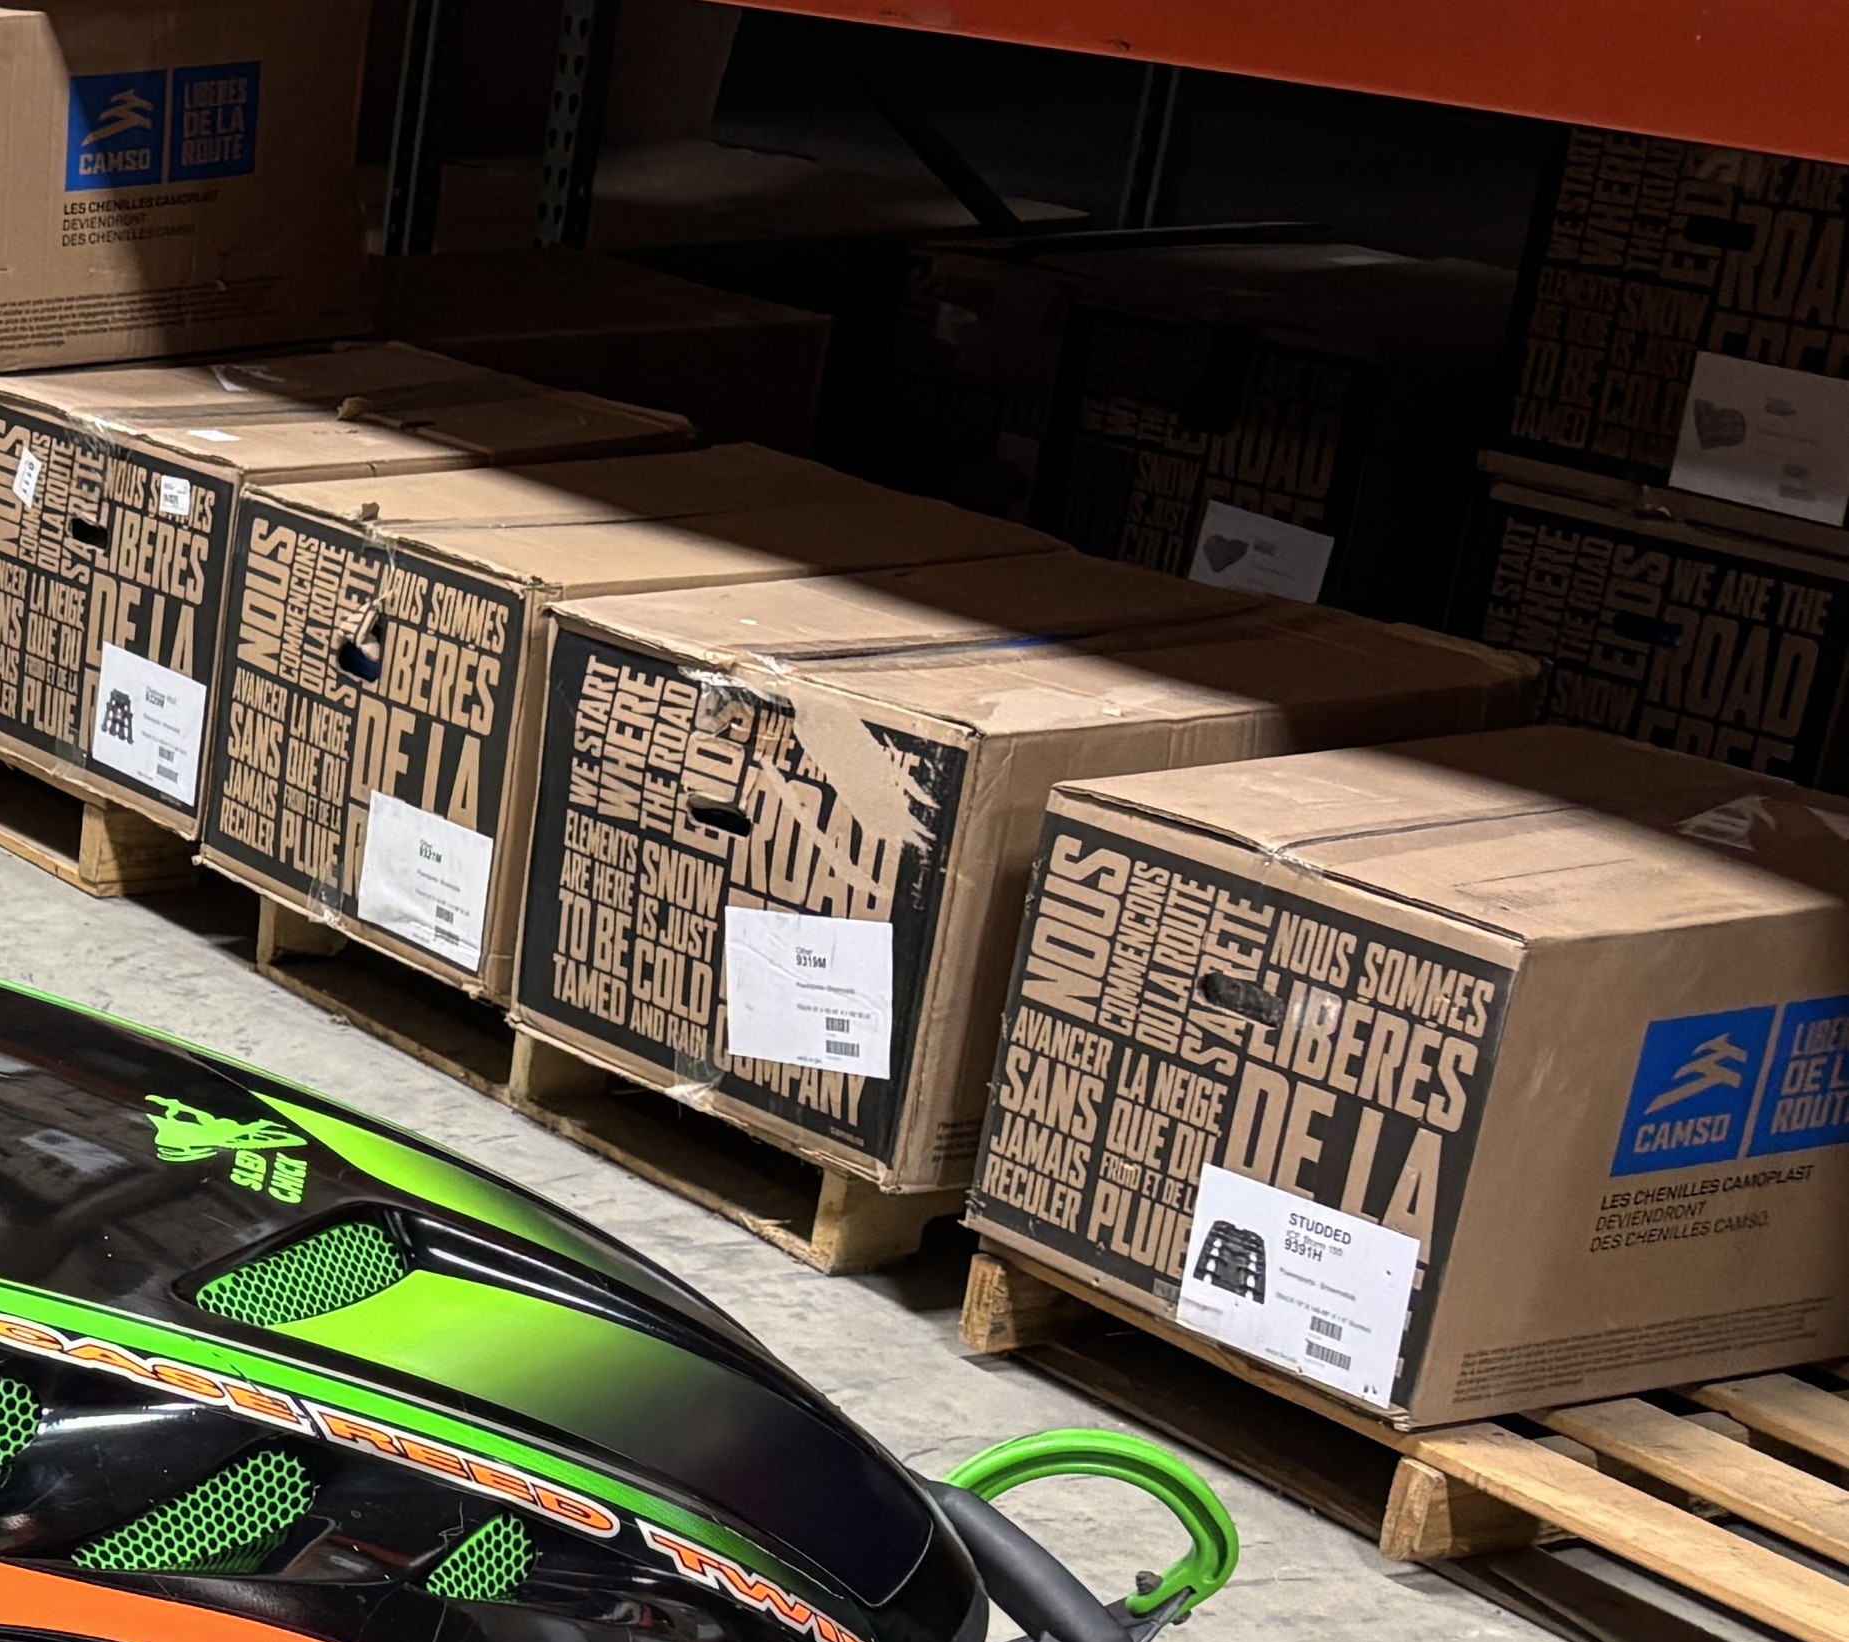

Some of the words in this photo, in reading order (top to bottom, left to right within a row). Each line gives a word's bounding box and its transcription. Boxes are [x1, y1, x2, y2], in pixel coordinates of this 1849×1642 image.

[181, 134, 244, 167] ROUTE
[183, 109, 212, 137] DE
[216, 106, 245, 134] LA
[78, 148, 151, 177] CAMSO
[61, 232, 86, 247] DES
[88, 227, 154, 245] CHENILLES
[62, 212, 147, 232] DEVIENDRONT
[63, 202, 87, 216] LES
[88, 196, 155, 214] CHENILLES
[1617, 278, 1711, 342] SNOW
[44, 437, 75, 512] ROUTE
[104, 457, 148, 510] NOUS
[29, 573, 47, 613] LA
[308, 541, 346, 626] ROUTE
[1490, 516, 1540, 602] START
[1511, 523, 1581, 654] WHERE
[1566, 534, 1616, 612] ROAD
[85, 571, 142, 668] DE
[236, 517, 297, 676] NOUS
[427, 582, 509, 654] SOMMES
[1670, 556, 1718, 608] WE
[1713, 567, 1777, 623] ARE
[1776, 580, 1834, 637] THE
[26, 612, 58, 663] QUE
[58, 624, 84, 673] DU
[1556, 609, 1599, 663] THE
[1645, 603, 1821, 740] ROAD
[21, 675, 78, 746] PLUIE
[231, 667, 288, 723] AVANCER
[289, 692, 308, 737] LA
[574, 654, 622, 758] START
[650, 680, 699, 774] ROAD
[1551, 668, 1639, 734] SNOW
[227, 701, 284, 780] SANS
[285, 737, 320, 800] QUE
[320, 751, 348, 808] DU
[349, 694, 417, 804] DE
[597, 665, 665, 822] WHERE
[753, 708, 796, 772] WE
[223, 761, 279, 820] JAMAIS
[568, 756, 600, 807] WE
[640, 771, 681, 834] THE
[219, 796, 276, 859] RECULER
[279, 808, 341, 889] PLUIE
[564, 808, 639, 874] ELEMENTS
[729, 766, 902, 923] ROAD
[559, 850, 590, 894] ARE
[591, 859, 635, 912] HERE
[639, 839, 725, 920] SNOW
[558, 888, 593, 961] TO
[593, 903, 632, 978] BE
[636, 893, 659, 936] IS
[659, 905, 718, 964] JUST
[1021, 834, 1132, 1024] NOUS
[1151, 873, 1217, 975] ROUTE
[553, 952, 627, 1026] TAMED
[632, 936, 713, 1025] COLD
[1143, 969, 1193, 1013] LA
[1269, 910, 1357, 989] NOUS
[1356, 942, 1494, 1038] SOMMES
[630, 1001, 666, 1045] AND
[666, 1013, 708, 1060] RAIN
[1010, 1005, 1114, 1080] AVANCER
[998, 1047, 1105, 1144] SANS
[1115, 1046, 1152, 1106] LA
[1781, 1059, 1827, 1096] DE
[989, 1111, 1091, 1190] JAMAIS
[1106, 1100, 1170, 1171] QUE
[1166, 1124, 1221, 1185] DU
[1223, 1060, 1338, 1202] DE
[1339, 1106, 1443, 1265] LA
[1634, 1112, 1732, 1154] CAMSO
[230, 1150, 267, 1192] SLED
[268, 1151, 308, 1204] CHICK
[981, 1158, 1083, 1233] RECULER
[1142, 1170, 1163, 1197] ET
[1163, 1180, 1183, 1207] DE
[1600, 1192, 1632, 1211] LES
[1633, 1178, 1721, 1206] CHENILLES
[1721, 1164, 1816, 1191] CAMOPLAST
[1086, 1178, 1193, 1279] PLUIE
[1284, 1238, 1323, 1262] 9391H
[1288, 1213, 1352, 1245] STUDDED
[1590, 1235, 1623, 1253] DES
[1624, 1220, 1712, 1247] CHENILLES
[1595, 1200, 1707, 1232] DEVIENDRONT
[302, 1401, 621, 1539] REED
